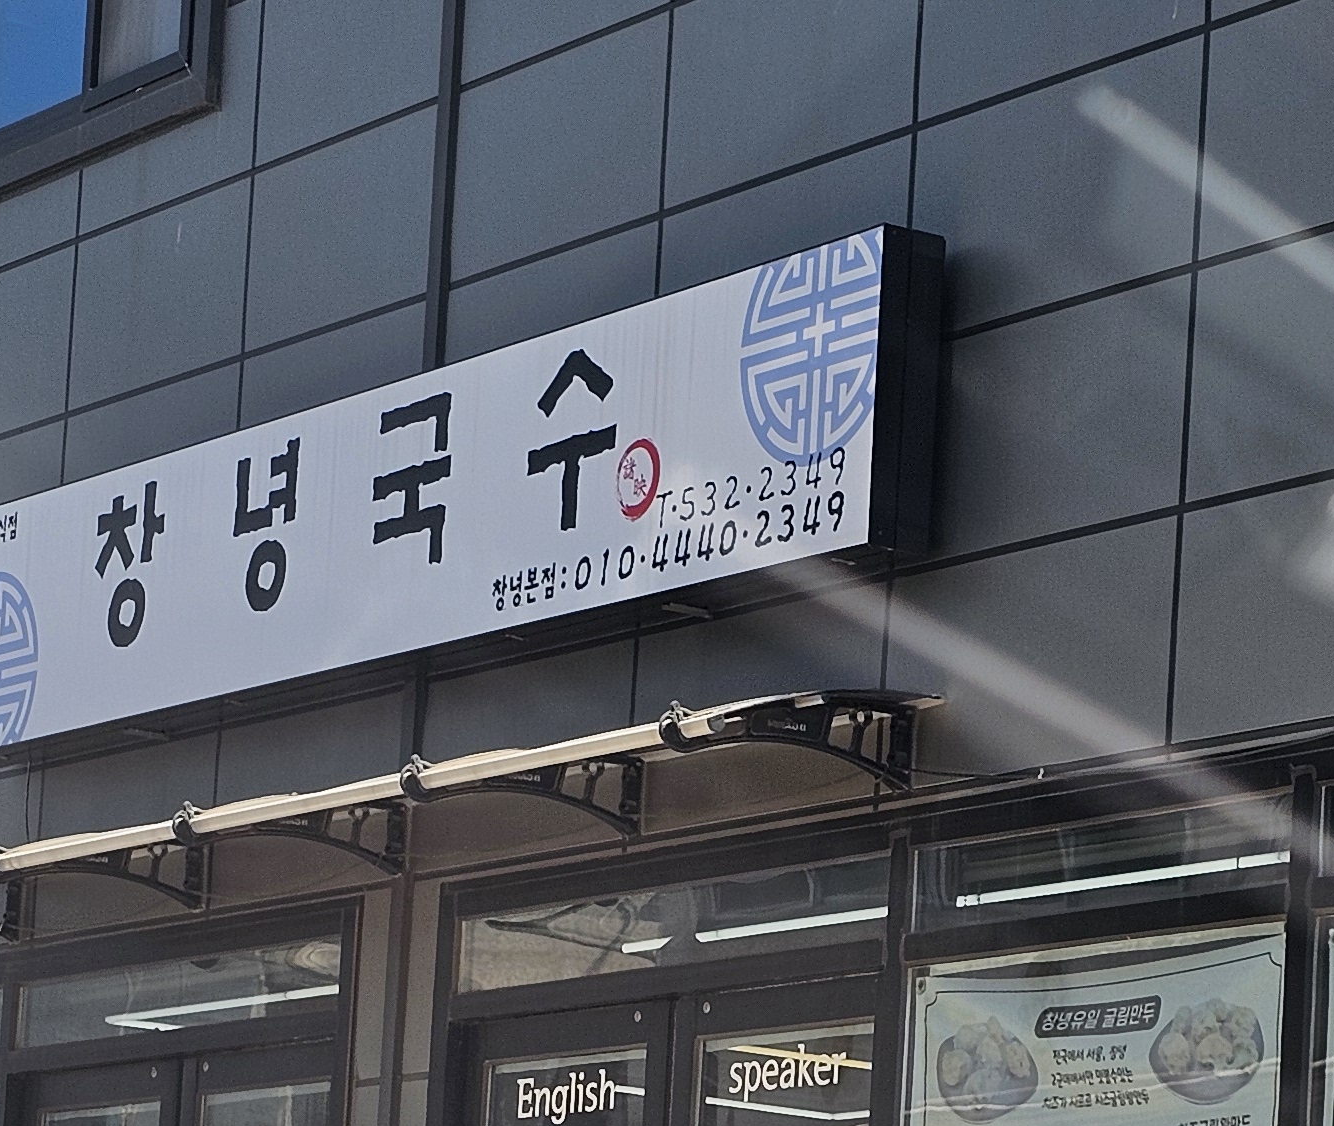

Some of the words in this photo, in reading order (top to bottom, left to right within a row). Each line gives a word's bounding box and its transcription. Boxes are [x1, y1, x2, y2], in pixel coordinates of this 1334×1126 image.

[95, 347, 617, 648] 창녕국수
[1042, 1010, 1100, 1031] 창녕유일
[1102, 1002, 1156, 1028] 굴림만두
[517, 1069, 616, 1124] English
[728, 1043, 847, 1102] speaker
